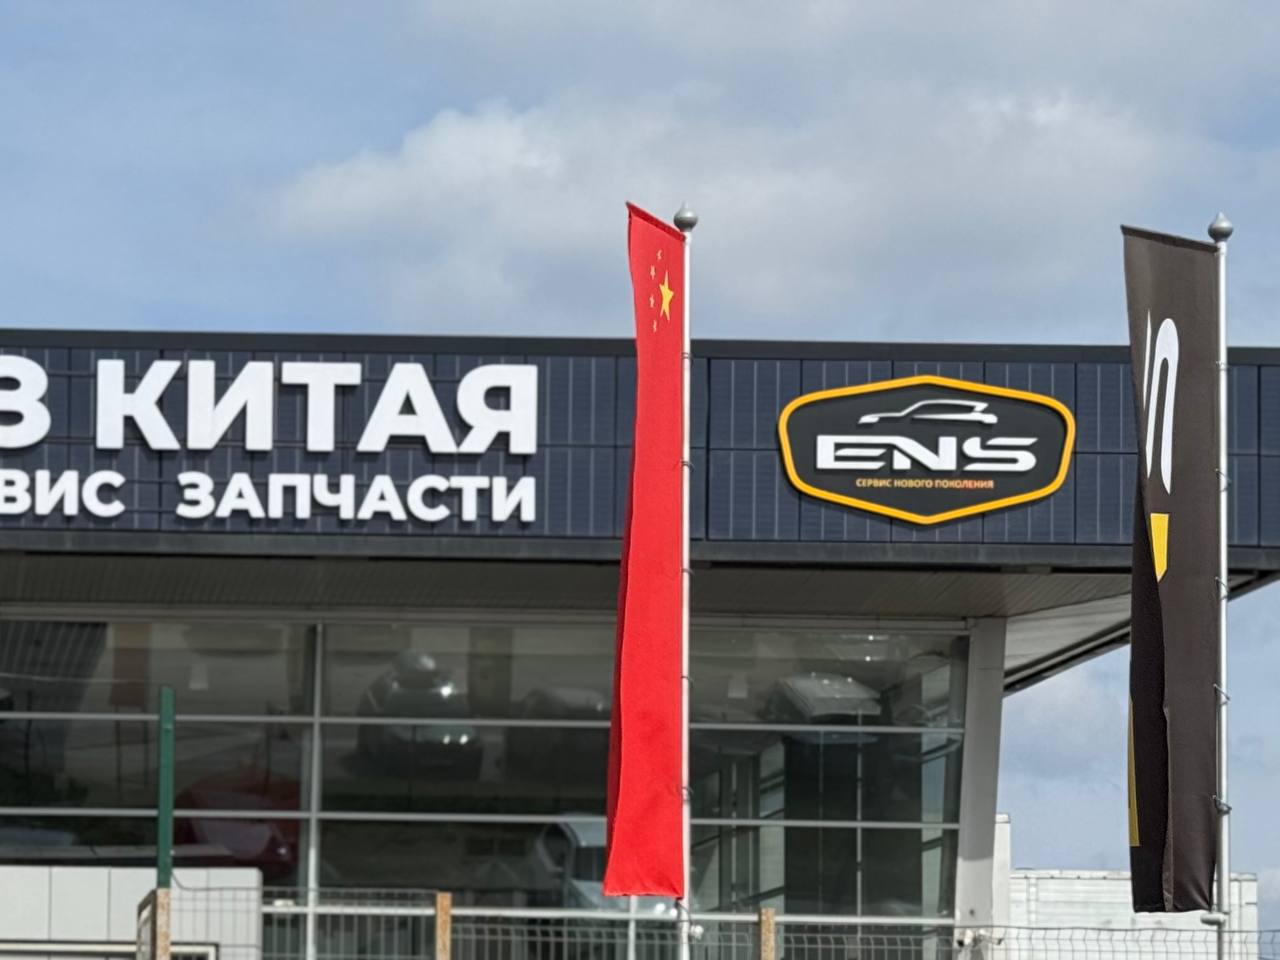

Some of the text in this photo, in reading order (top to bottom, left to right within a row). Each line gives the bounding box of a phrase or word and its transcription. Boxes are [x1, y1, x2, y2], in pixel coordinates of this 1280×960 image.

[96, 359, 539, 455] КИТАЯ
[816, 435, 1038, 472] ENS
[176, 471, 536, 522] ЗАПЧАСТИ
[856, 477, 994, 489] СЕРВИС НОВОГО ПОКОЛЕНИЯ
